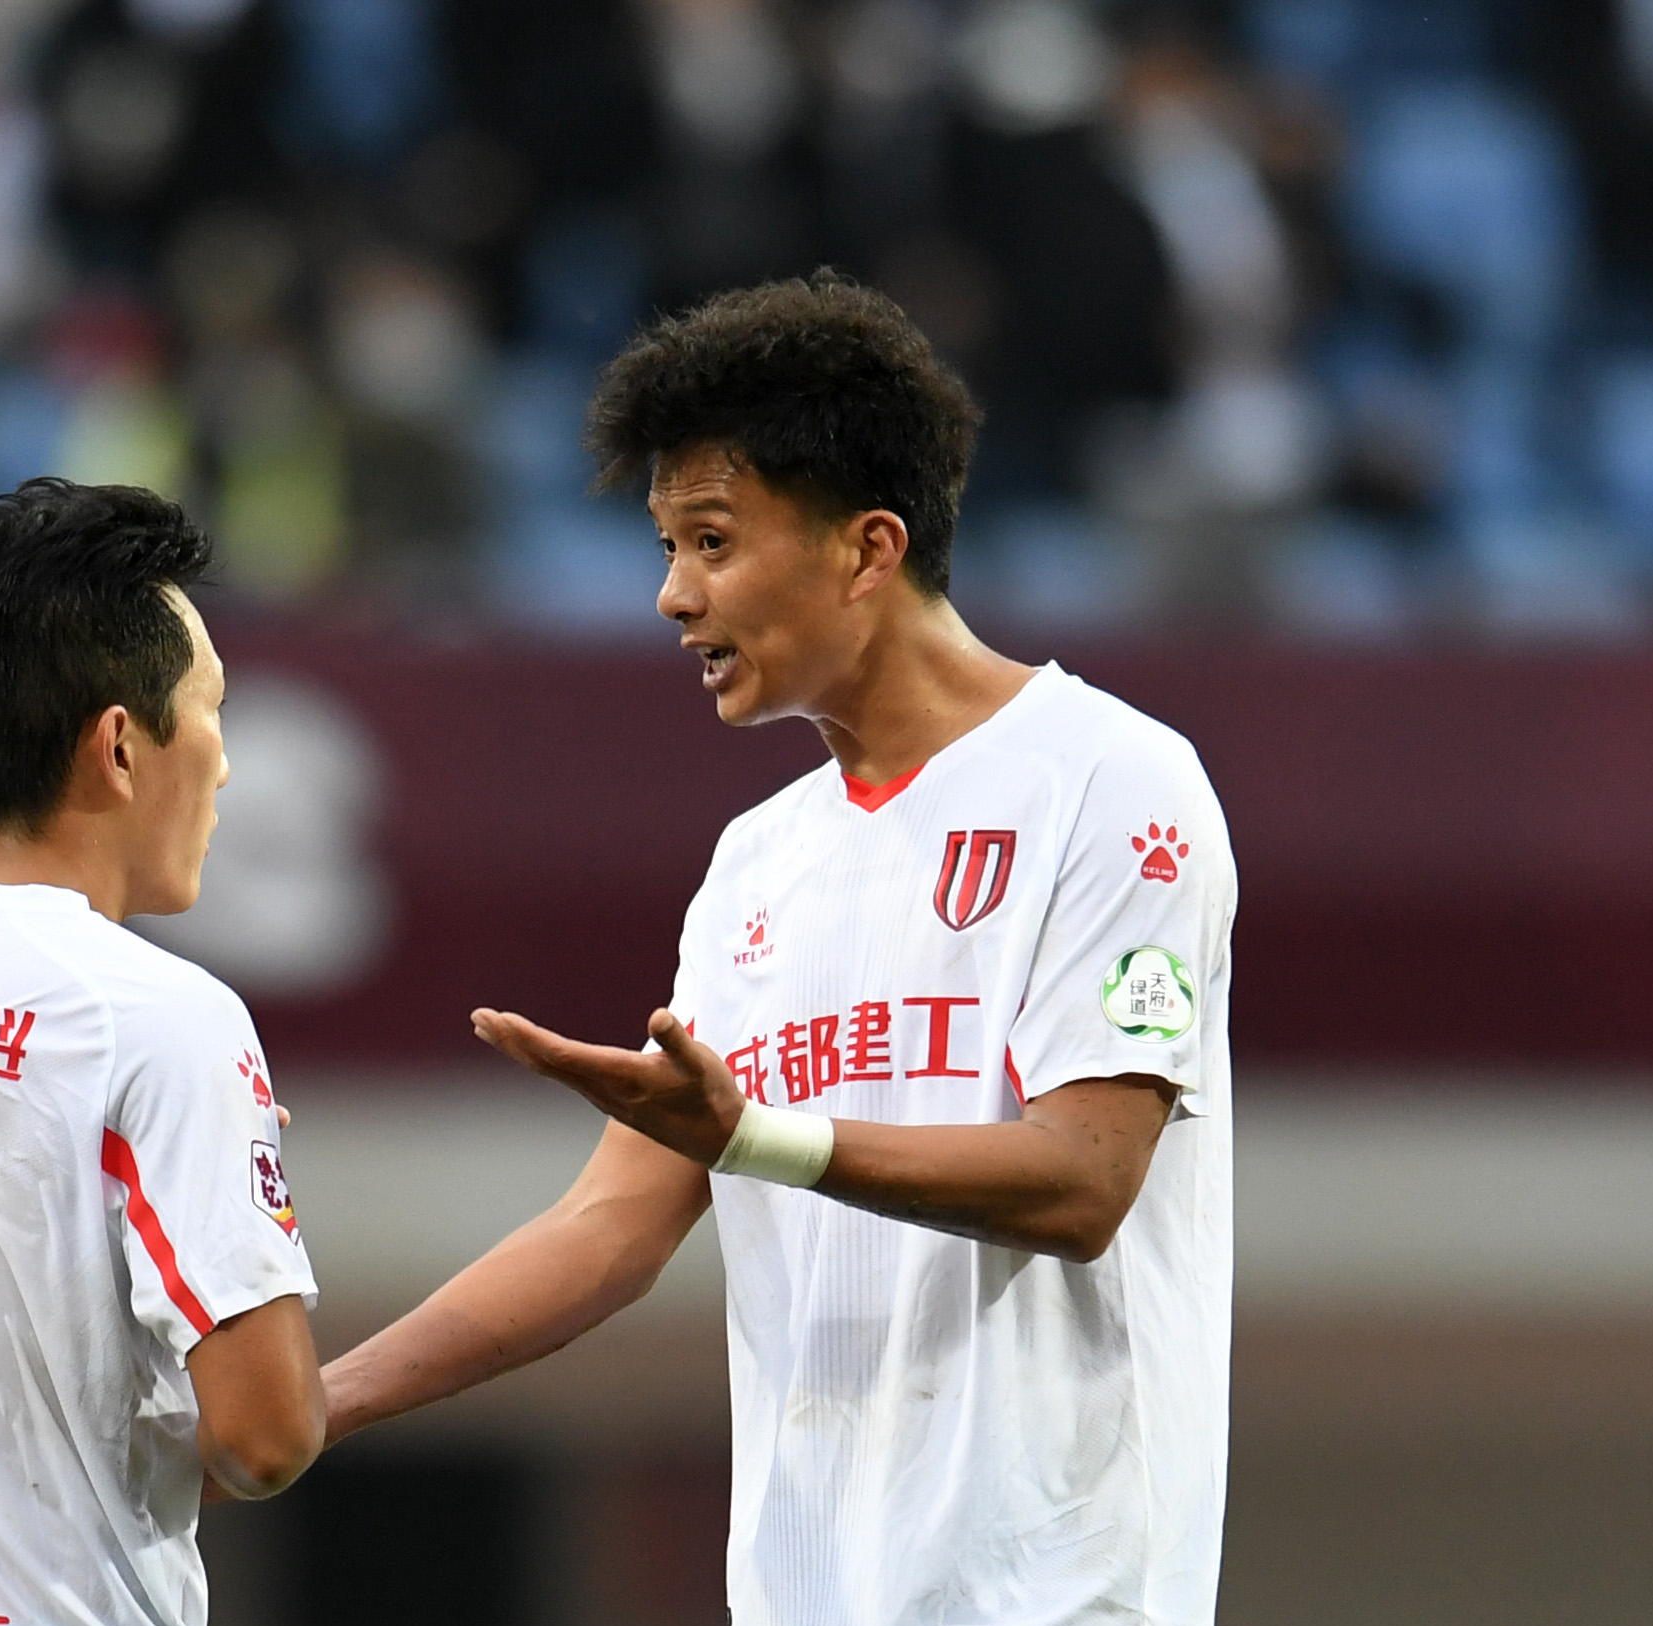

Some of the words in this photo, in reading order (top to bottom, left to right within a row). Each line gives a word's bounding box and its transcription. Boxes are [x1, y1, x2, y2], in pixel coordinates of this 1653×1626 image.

[1129, 979, 1147, 1015] 绿道
[1149, 972, 1166, 1008] 天府
[724, 997, 980, 1108] 成都建工
